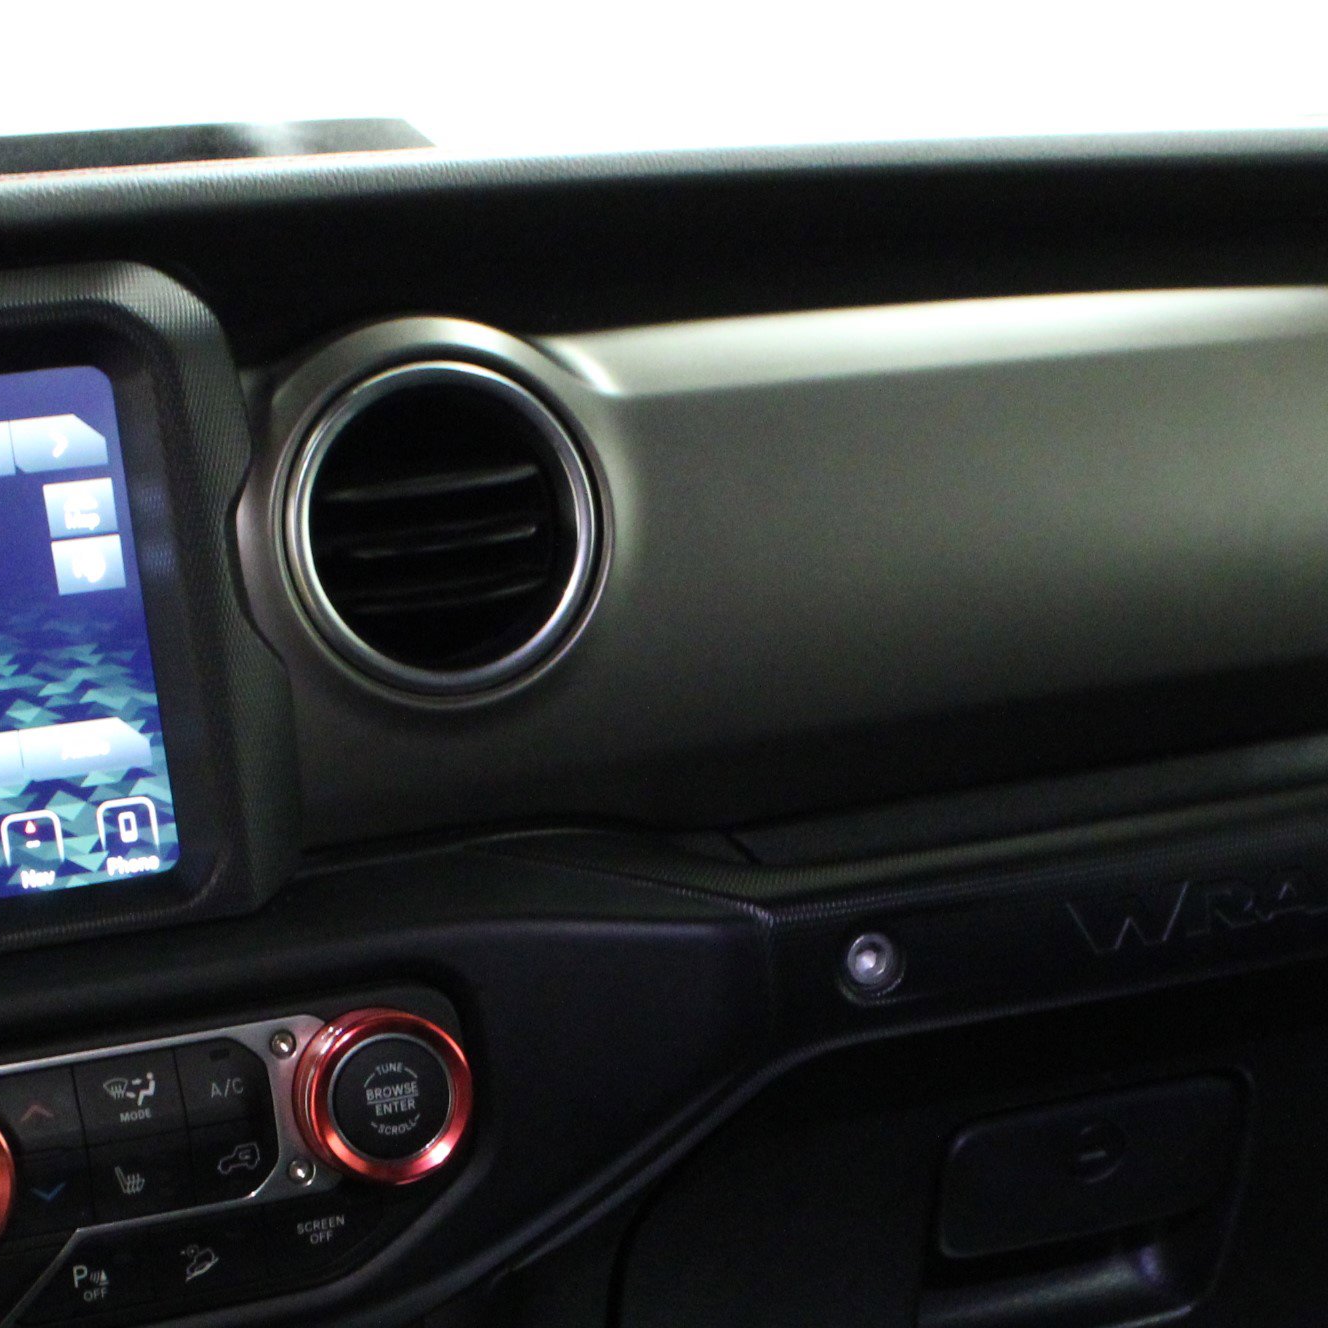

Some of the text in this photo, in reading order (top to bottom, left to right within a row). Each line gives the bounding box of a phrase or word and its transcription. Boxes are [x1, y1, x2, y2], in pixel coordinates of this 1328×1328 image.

[21, 869, 56, 890] Nav
[107, 855, 161, 877] Phone
[375, 1061, 404, 1076] TUNE
[210, 1077, 244, 1099] A/C
[365, 1081, 419, 1101] BROWSE
[119, 1107, 152, 1123] MODE
[375, 1098, 416, 1117] ENTER
[297, 1214, 346, 1236] SCREEN
[309, 1230, 334, 1246] OFF
[72, 1264, 89, 1289] P
[83, 1287, 108, 1303] OFF
